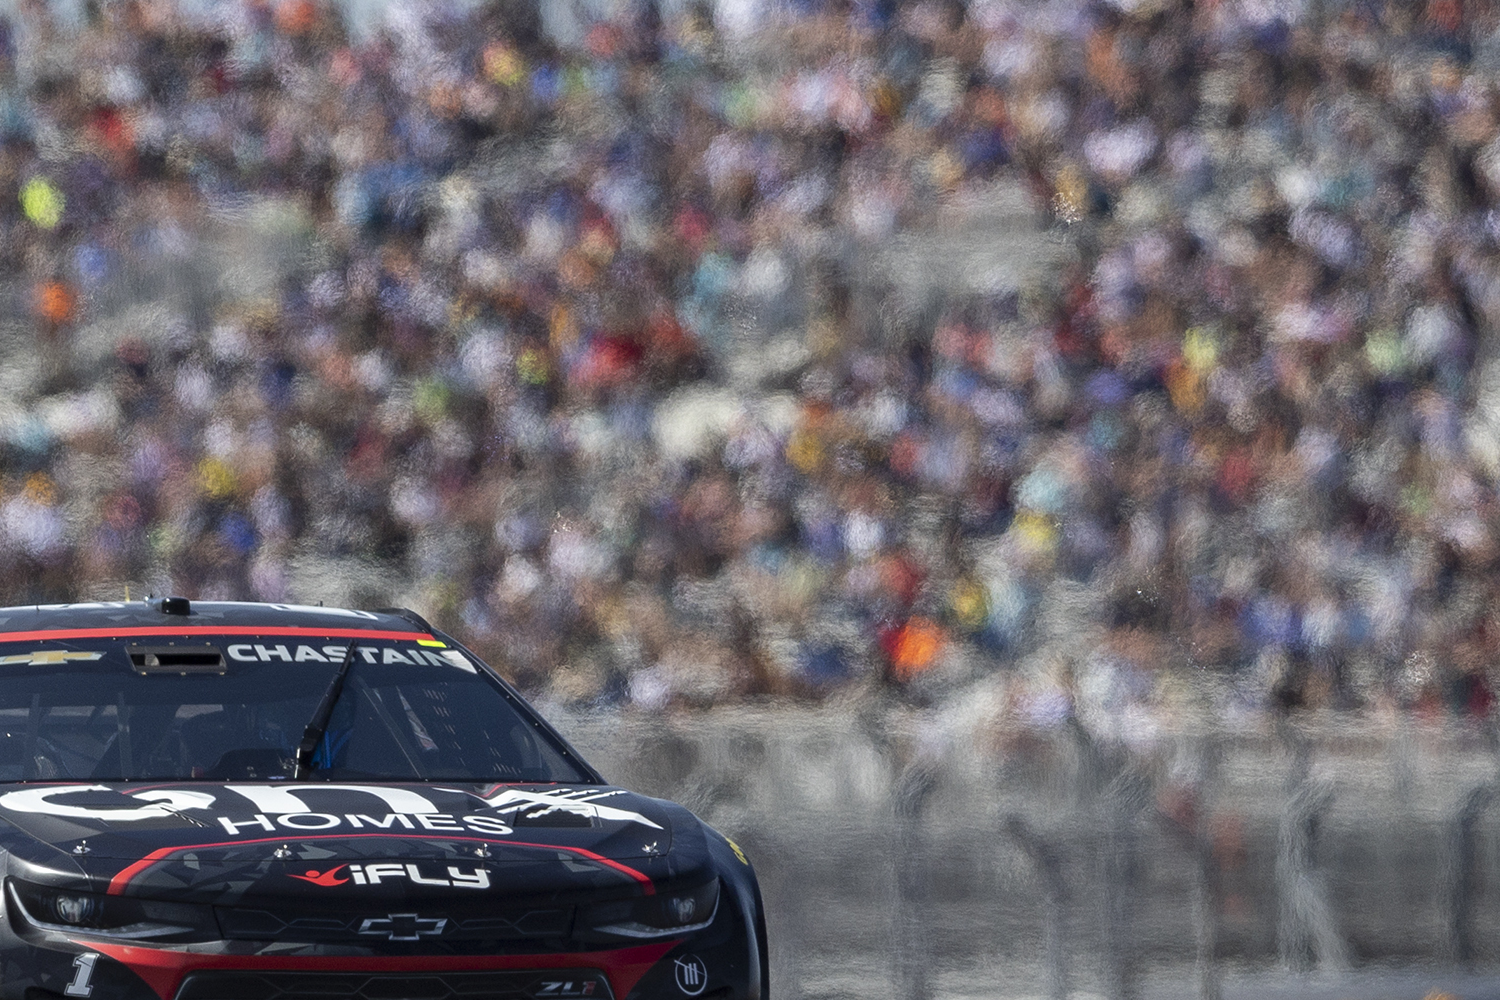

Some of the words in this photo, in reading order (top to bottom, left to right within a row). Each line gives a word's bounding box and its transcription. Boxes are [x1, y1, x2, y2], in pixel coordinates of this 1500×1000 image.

[227, 644, 456, 667] CHASTAIN
[217, 812, 514, 836] HOMES
[349, 863, 491, 889] iFLY
[64, 951, 100, 998] 1
[535, 980, 597, 997] ZL1
